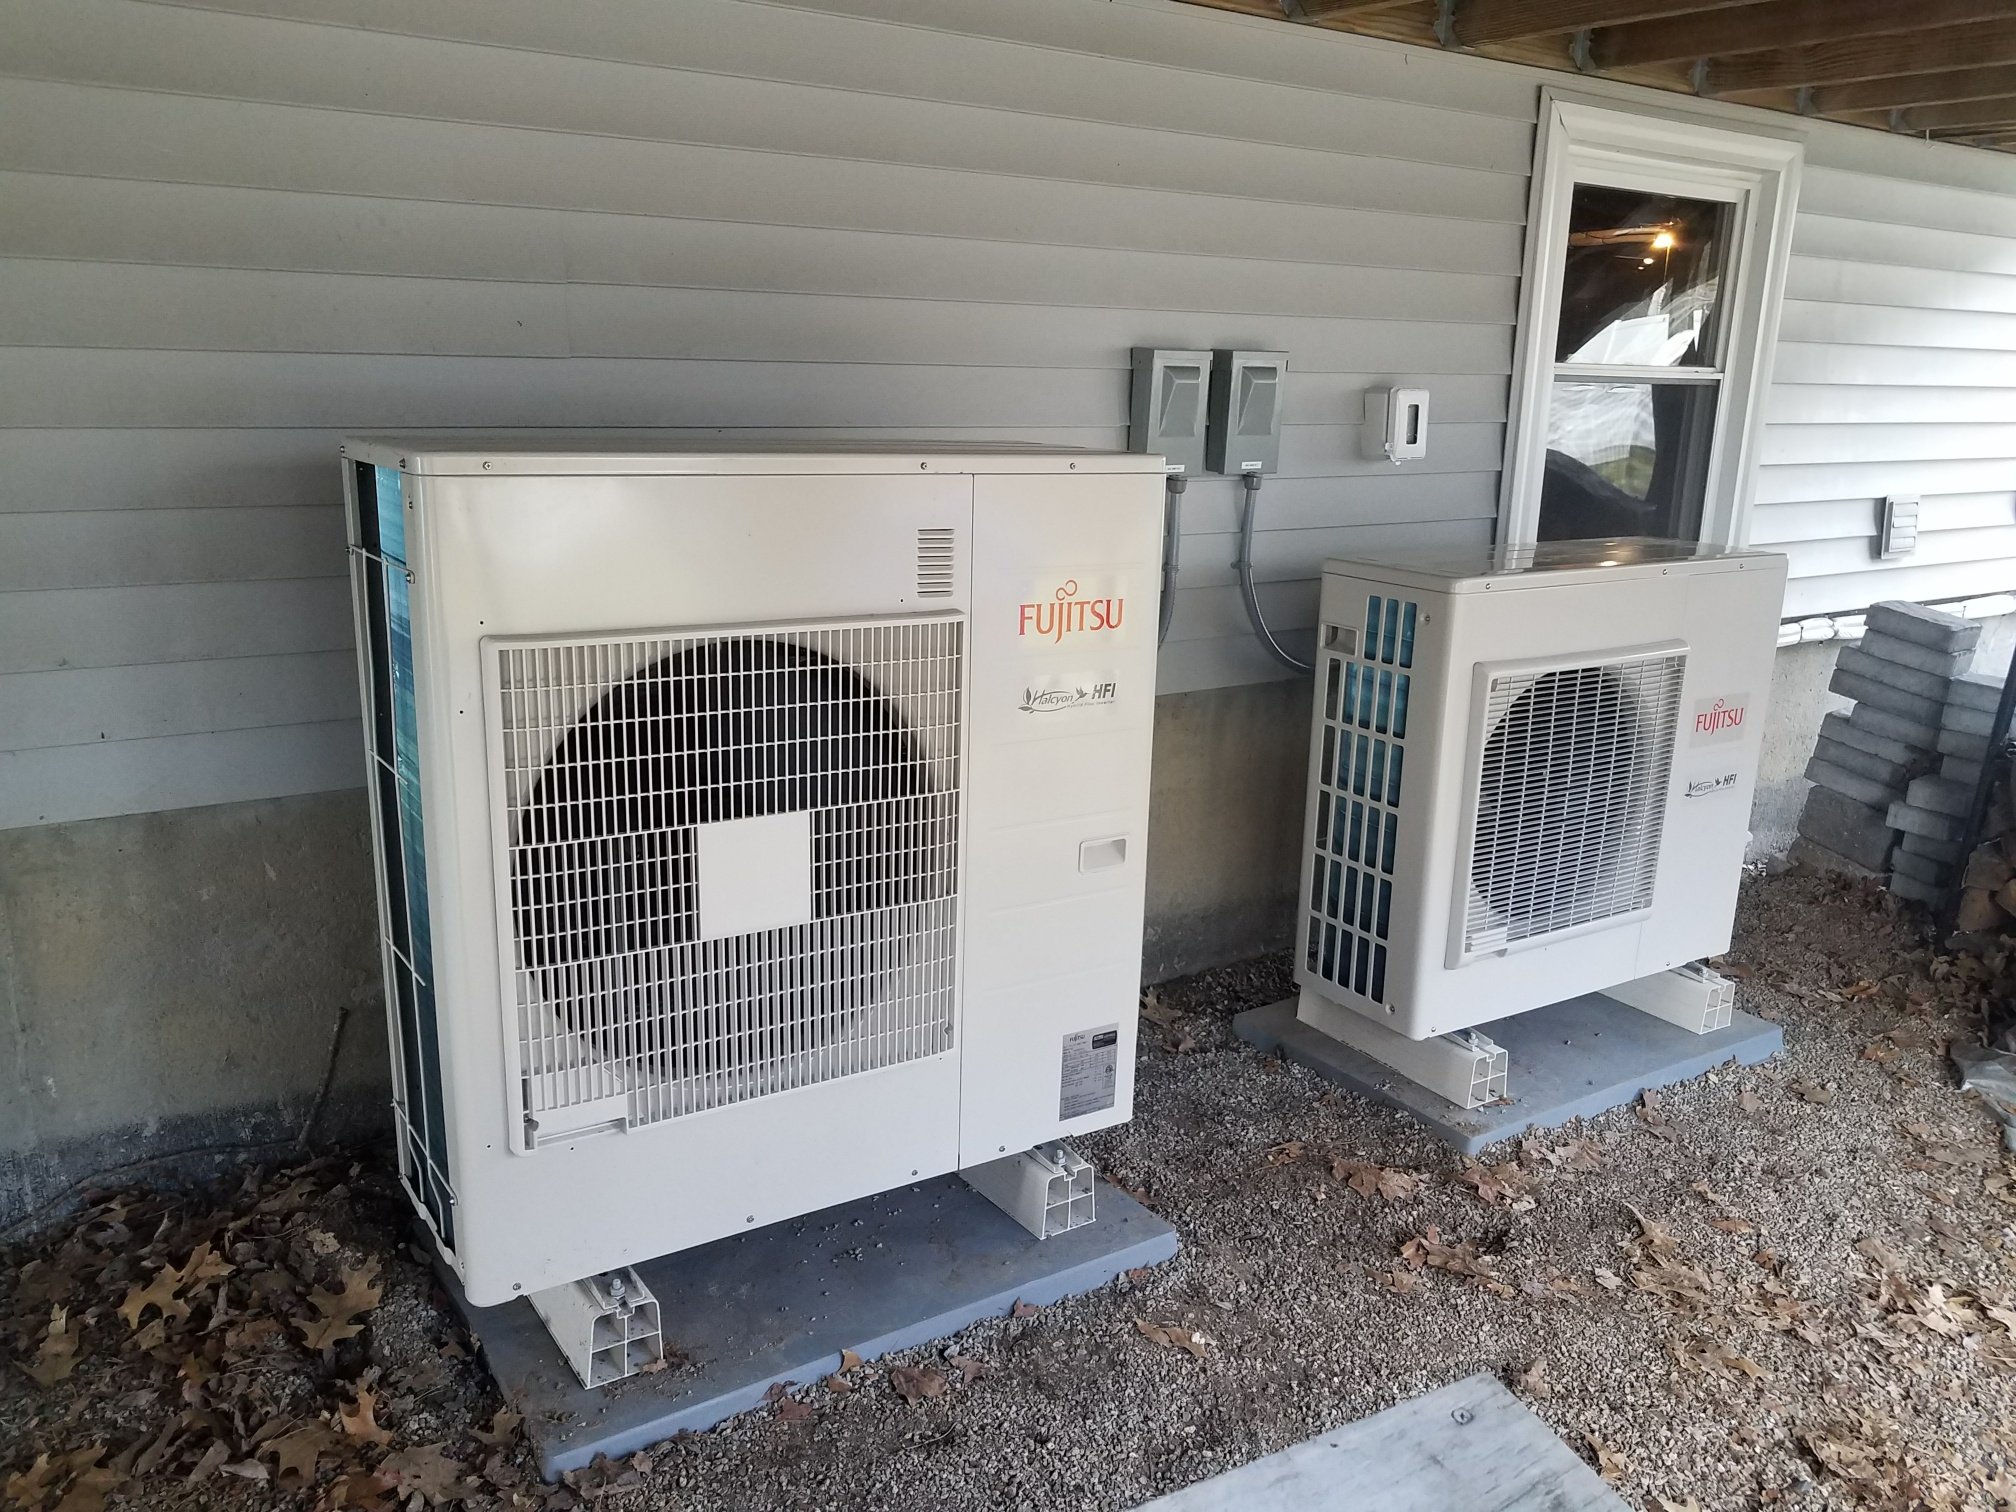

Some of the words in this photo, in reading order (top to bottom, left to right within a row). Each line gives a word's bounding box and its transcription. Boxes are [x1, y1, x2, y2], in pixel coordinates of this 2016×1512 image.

[1018, 598, 1124, 645] FUJITSU
[1031, 689, 1074, 706] Halcyon
[1091, 682, 1117, 700] HFI
[1695, 707, 1744, 736] FUJITSU
[1722, 773, 1737, 787] HFI
